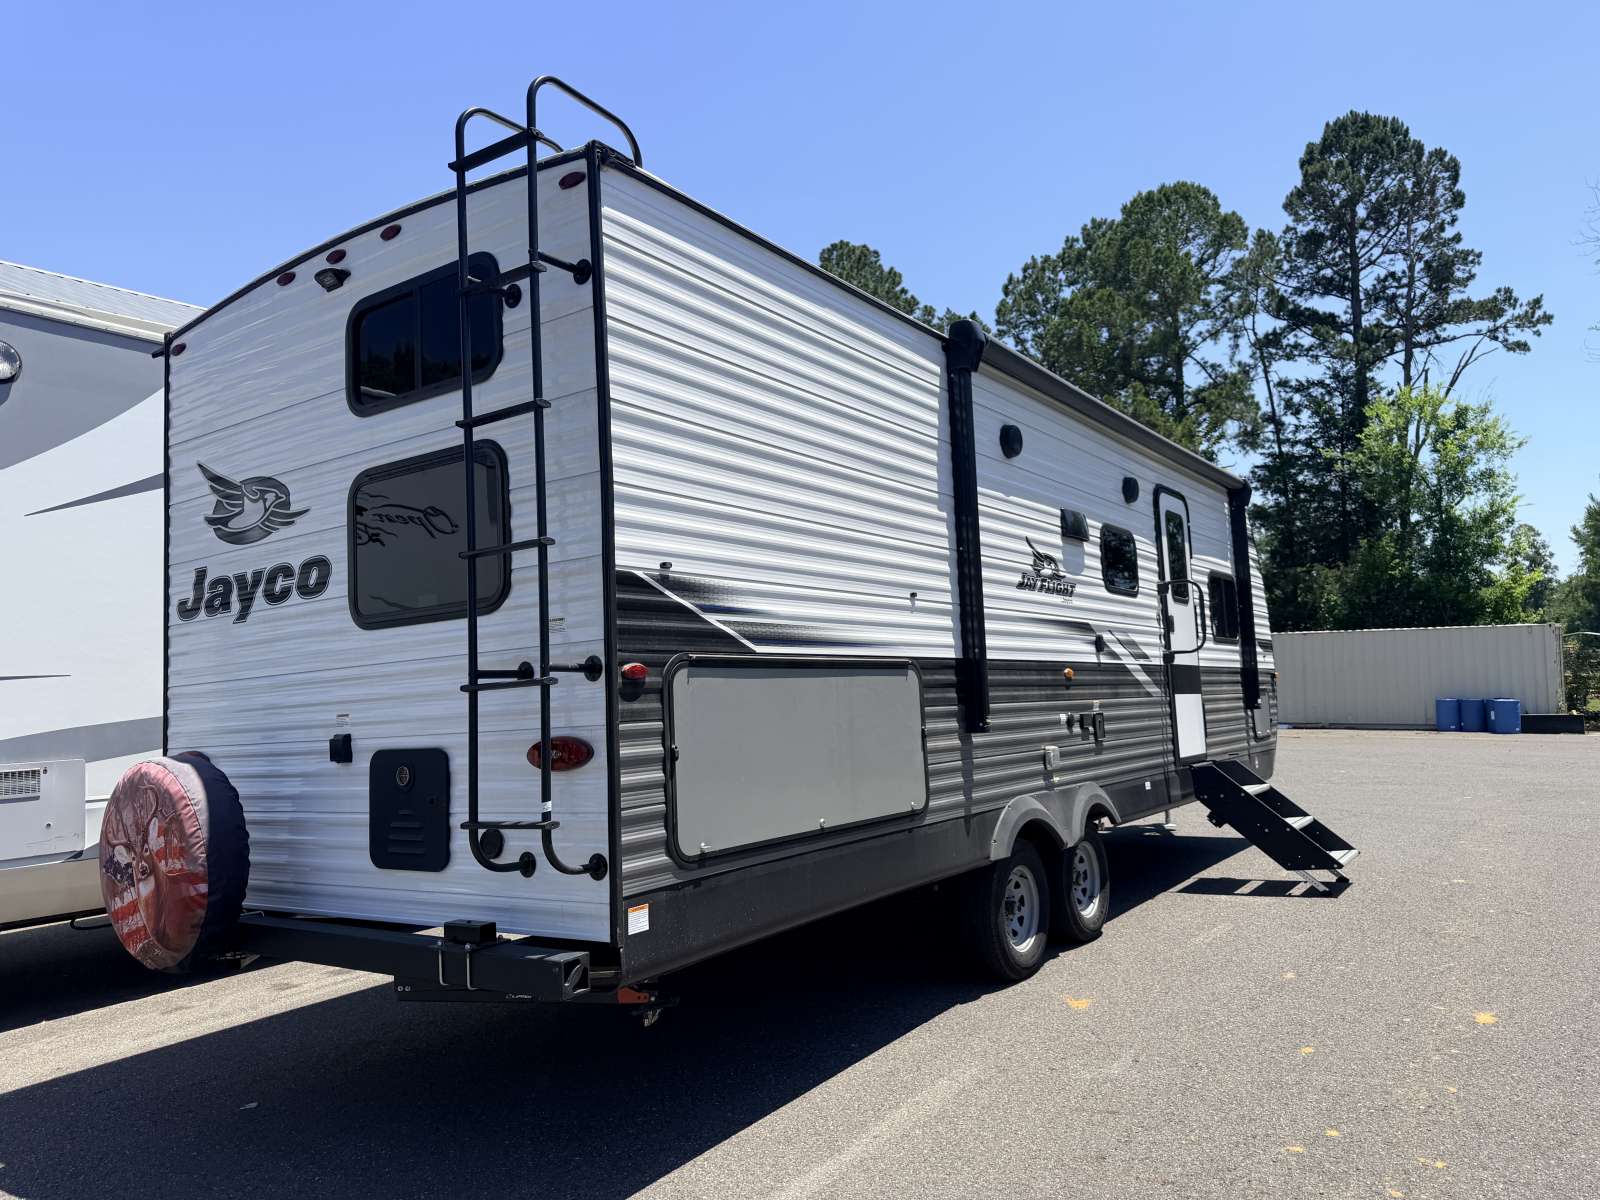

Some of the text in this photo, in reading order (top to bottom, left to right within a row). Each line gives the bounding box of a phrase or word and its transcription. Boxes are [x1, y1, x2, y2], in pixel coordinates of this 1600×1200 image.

[176, 554, 333, 625] Jayco
[1015, 572, 1077, 598] JAY FLIGHT
